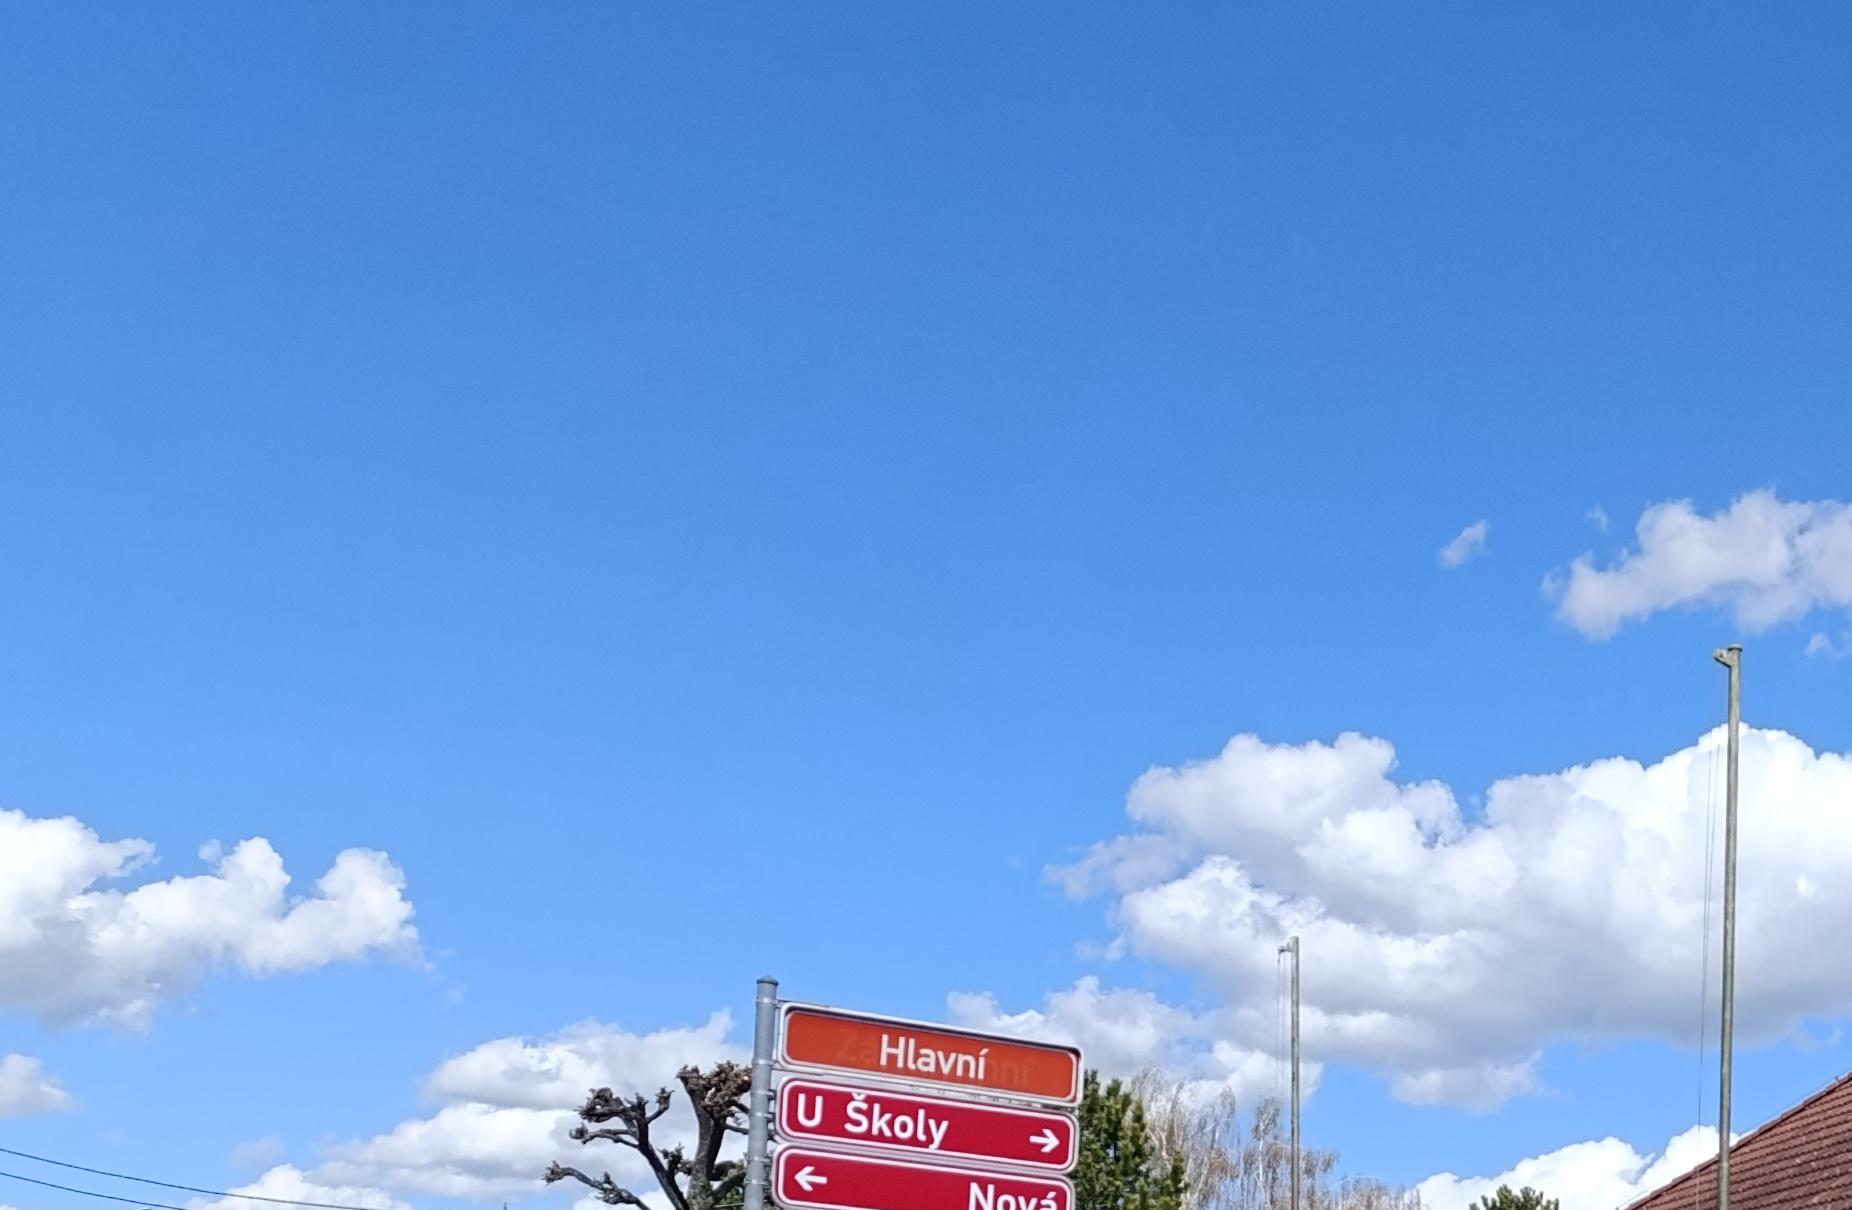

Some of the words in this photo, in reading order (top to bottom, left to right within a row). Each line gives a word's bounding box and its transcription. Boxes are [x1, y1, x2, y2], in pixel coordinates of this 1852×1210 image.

[880, 1033, 989, 1080] Hlavní
[797, 1093, 823, 1127] U
[844, 1092, 949, 1150] Školy
